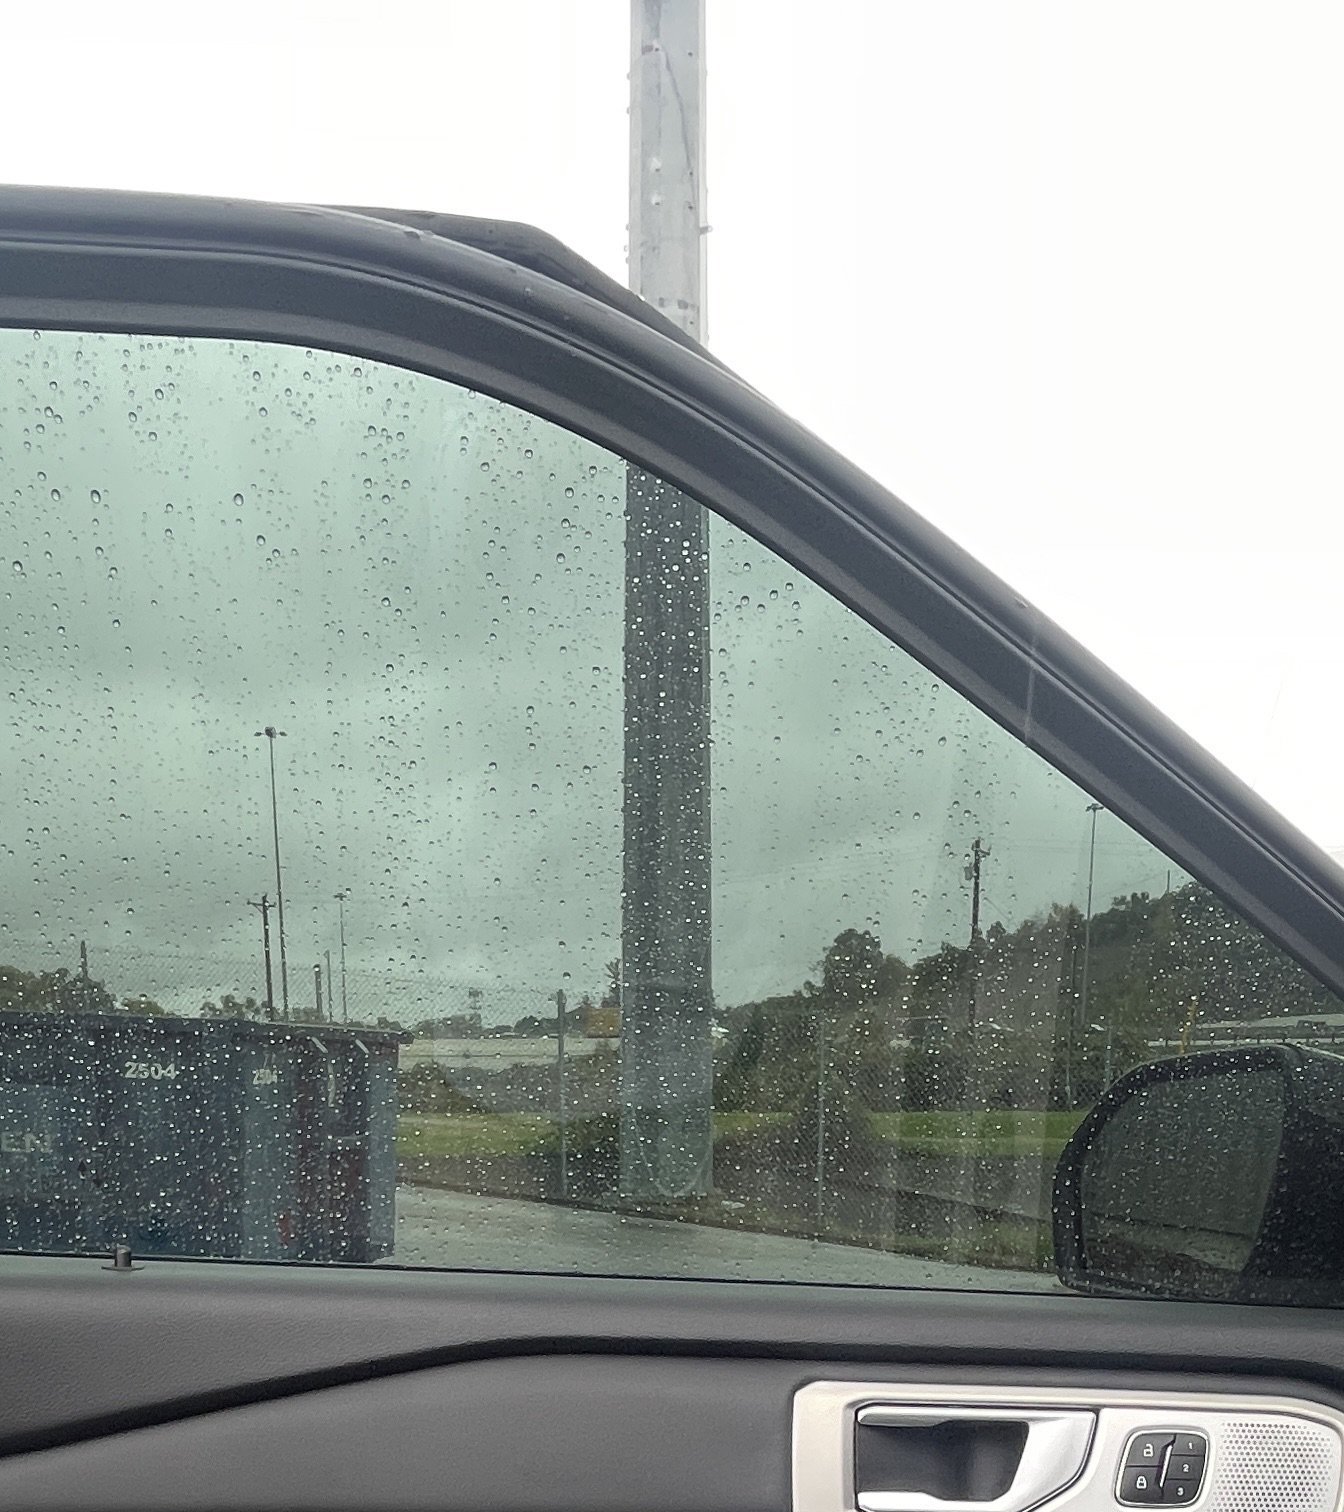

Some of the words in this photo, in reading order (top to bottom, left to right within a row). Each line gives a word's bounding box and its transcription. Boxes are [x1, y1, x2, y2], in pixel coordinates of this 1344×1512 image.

[123, 1061, 178, 1080] 2504
[1182, 1464, 1190, 1472] 2
[1177, 1487, 1184, 1496] 3
